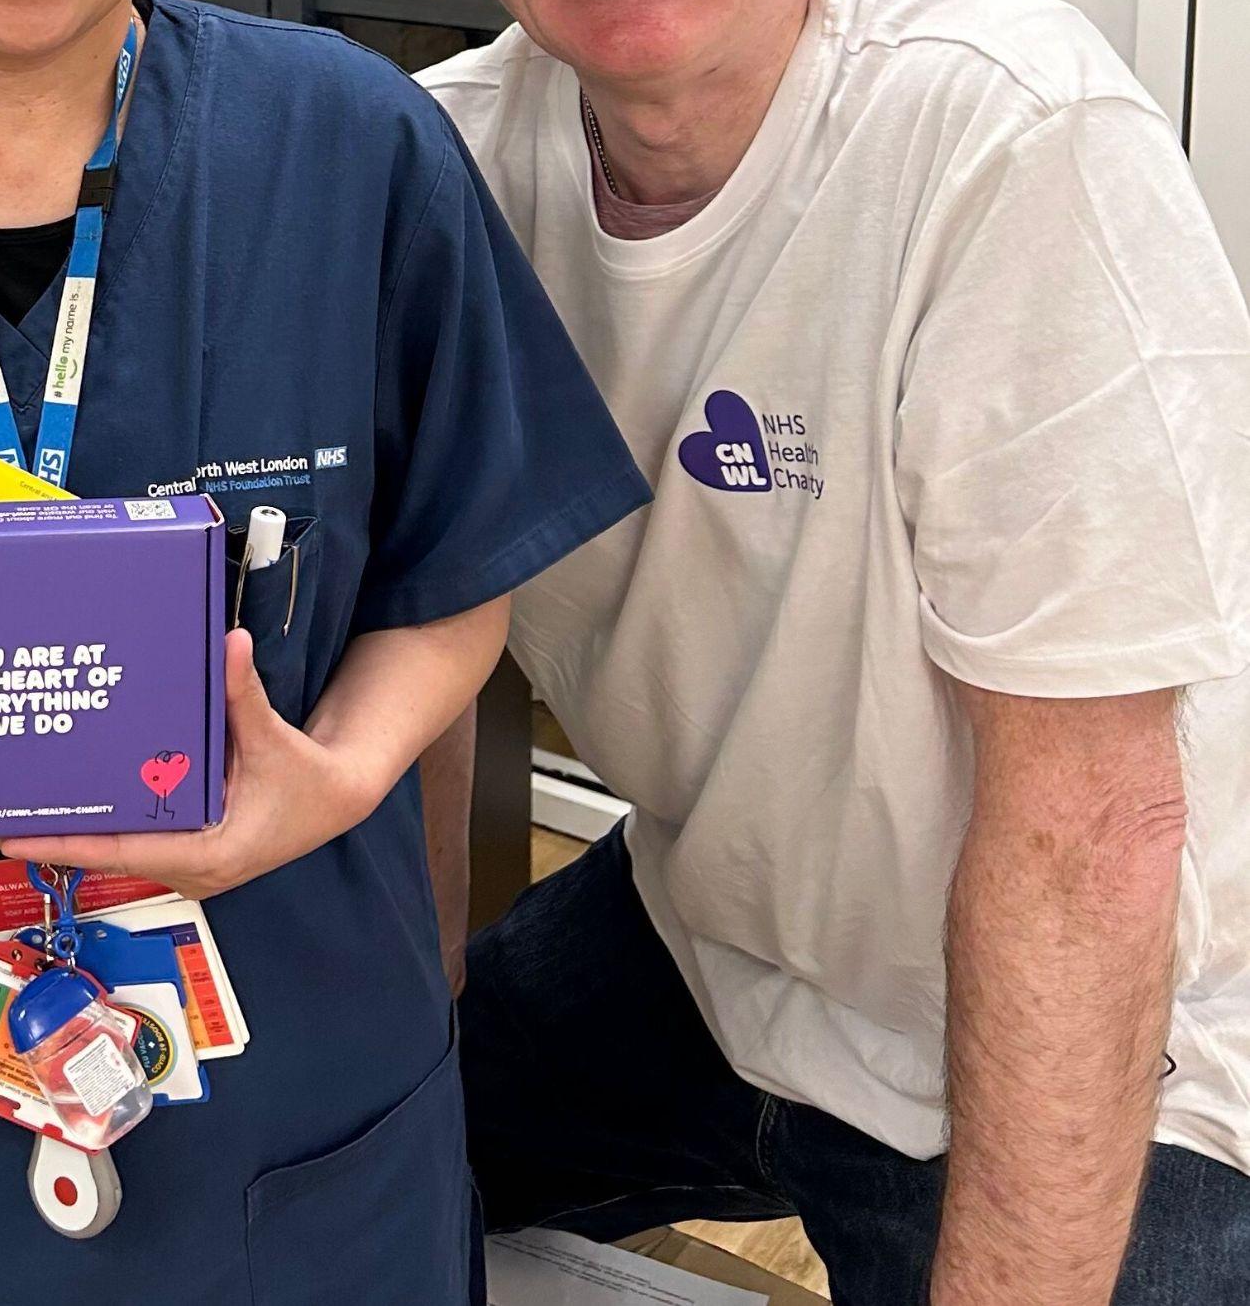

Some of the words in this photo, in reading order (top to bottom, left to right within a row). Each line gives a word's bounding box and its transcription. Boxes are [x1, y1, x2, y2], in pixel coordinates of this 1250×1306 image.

[66, 304, 77, 334] name
[62, 336, 74, 353] my
[762, 414, 806, 435] NHS
[715, 443, 754, 464] CN
[147, 477, 197, 498] Central
[224, 460, 259, 477] West
[260, 456, 308, 473] London
[316, 448, 346, 467] NHS
[205, 481, 228, 493] NHS
[229, 476, 284, 491] Foundation
[285, 474, 311, 487] Trust
[721, 465, 767, 486] WL
[12, 646, 65, 667] ARE
[73, 644, 106, 664] AT
[87, 666, 122, 686] OF
[34, 713, 73, 734] DO
